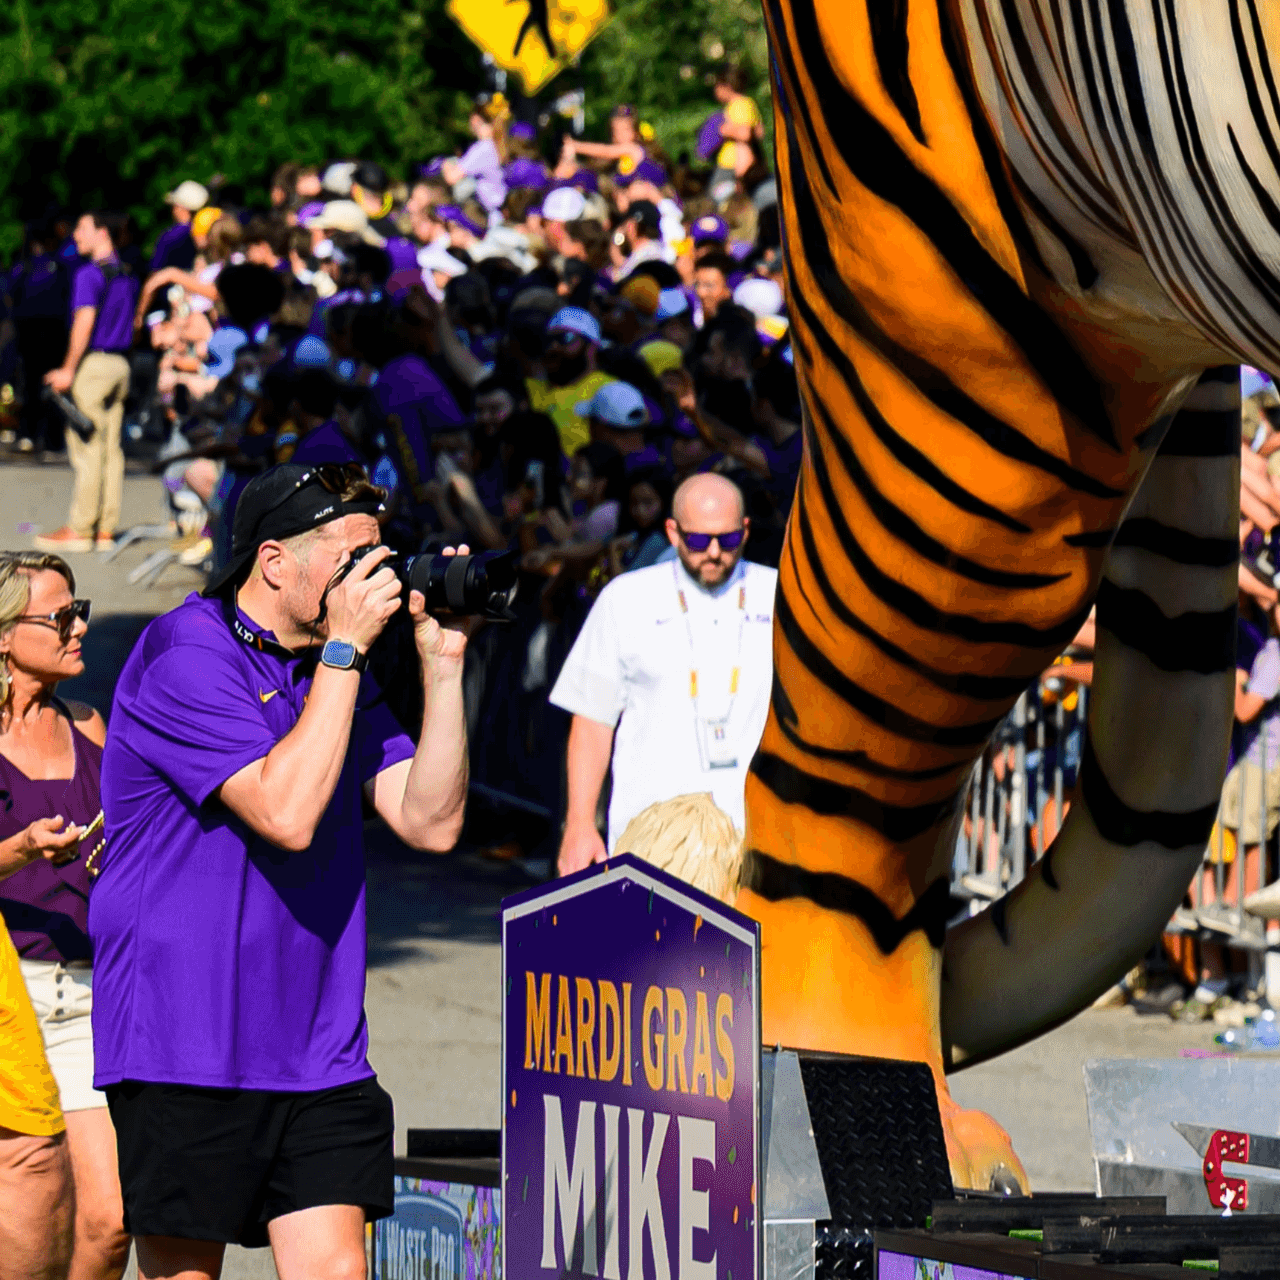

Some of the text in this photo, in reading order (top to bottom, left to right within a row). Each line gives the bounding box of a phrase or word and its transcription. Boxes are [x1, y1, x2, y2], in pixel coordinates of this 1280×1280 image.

[524, 971, 736, 1103] MARDI GRAS
[540, 1094, 718, 1280] MIKE
